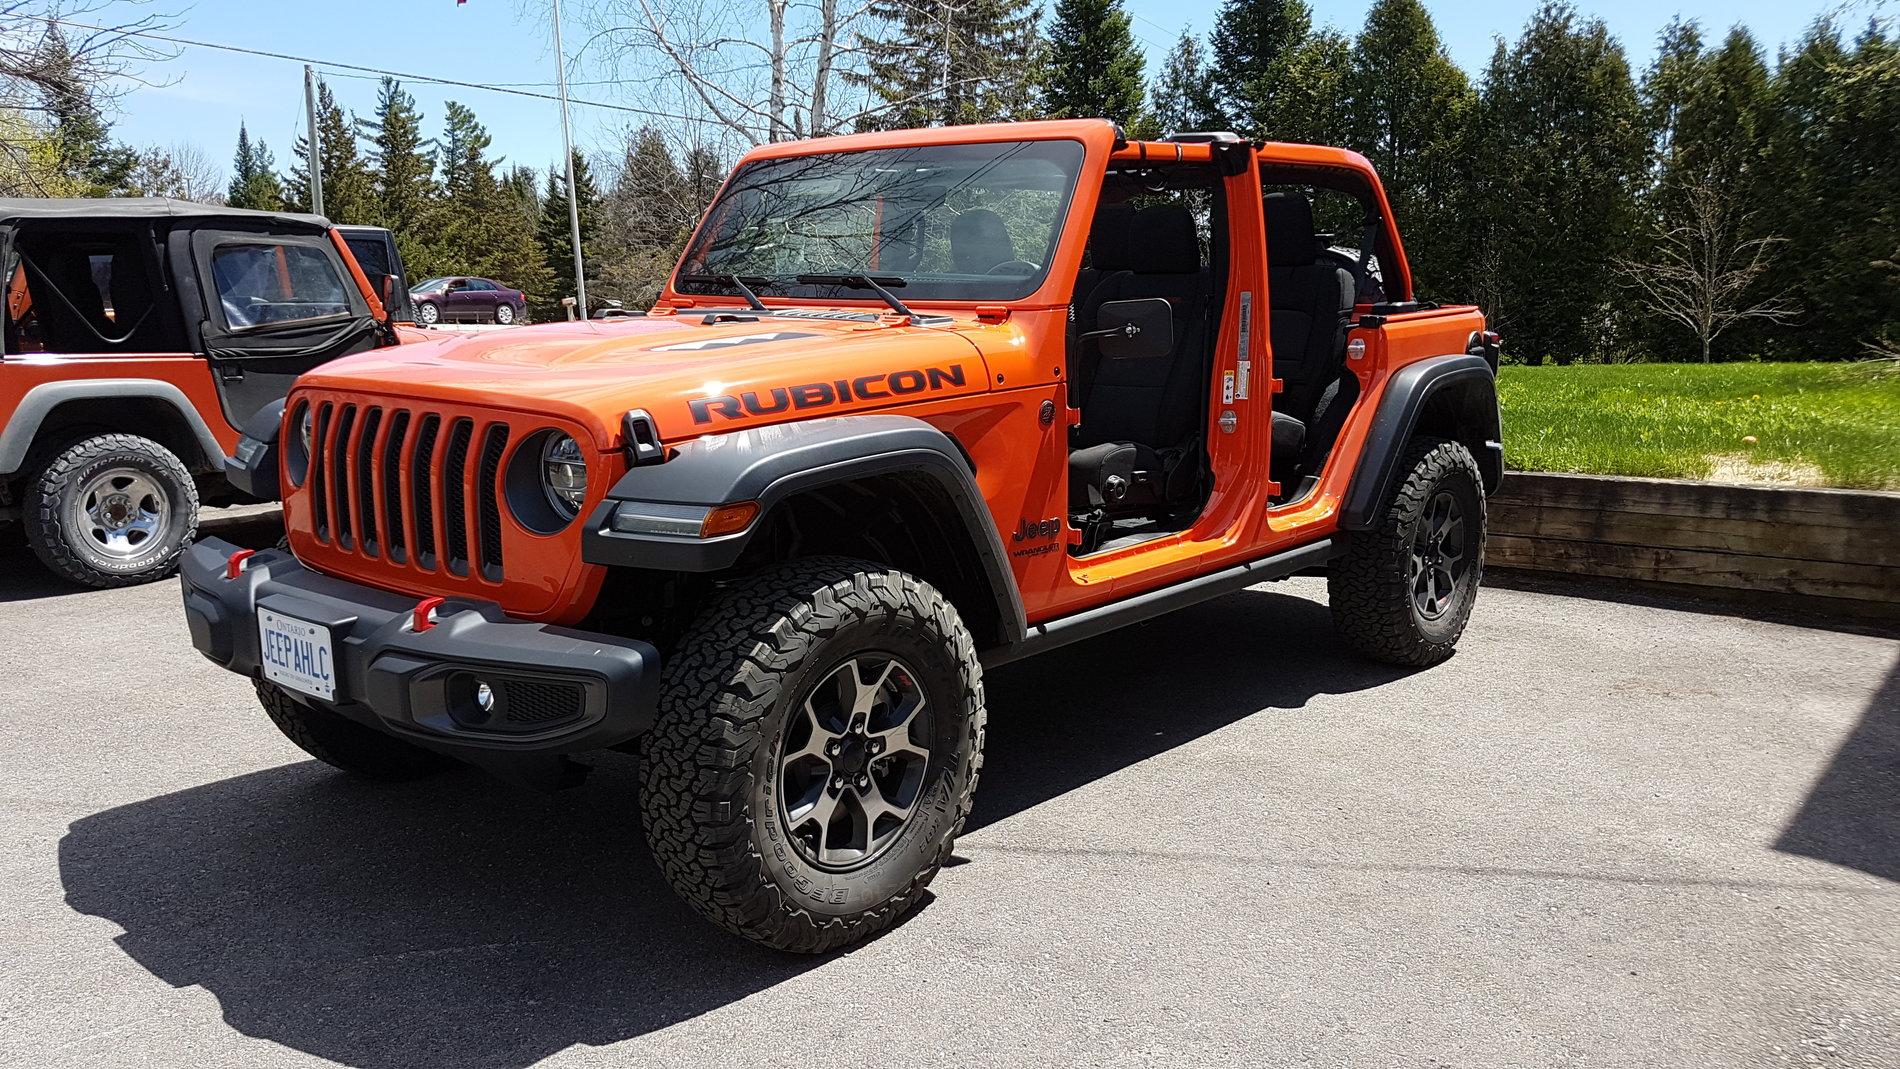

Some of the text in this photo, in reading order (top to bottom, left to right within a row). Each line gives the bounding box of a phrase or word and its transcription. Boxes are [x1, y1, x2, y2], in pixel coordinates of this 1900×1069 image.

[687, 364, 967, 425] RUBICON
[1012, 516, 1061, 542] Jeep
[89, 545, 170, 571] BFGoodrich
